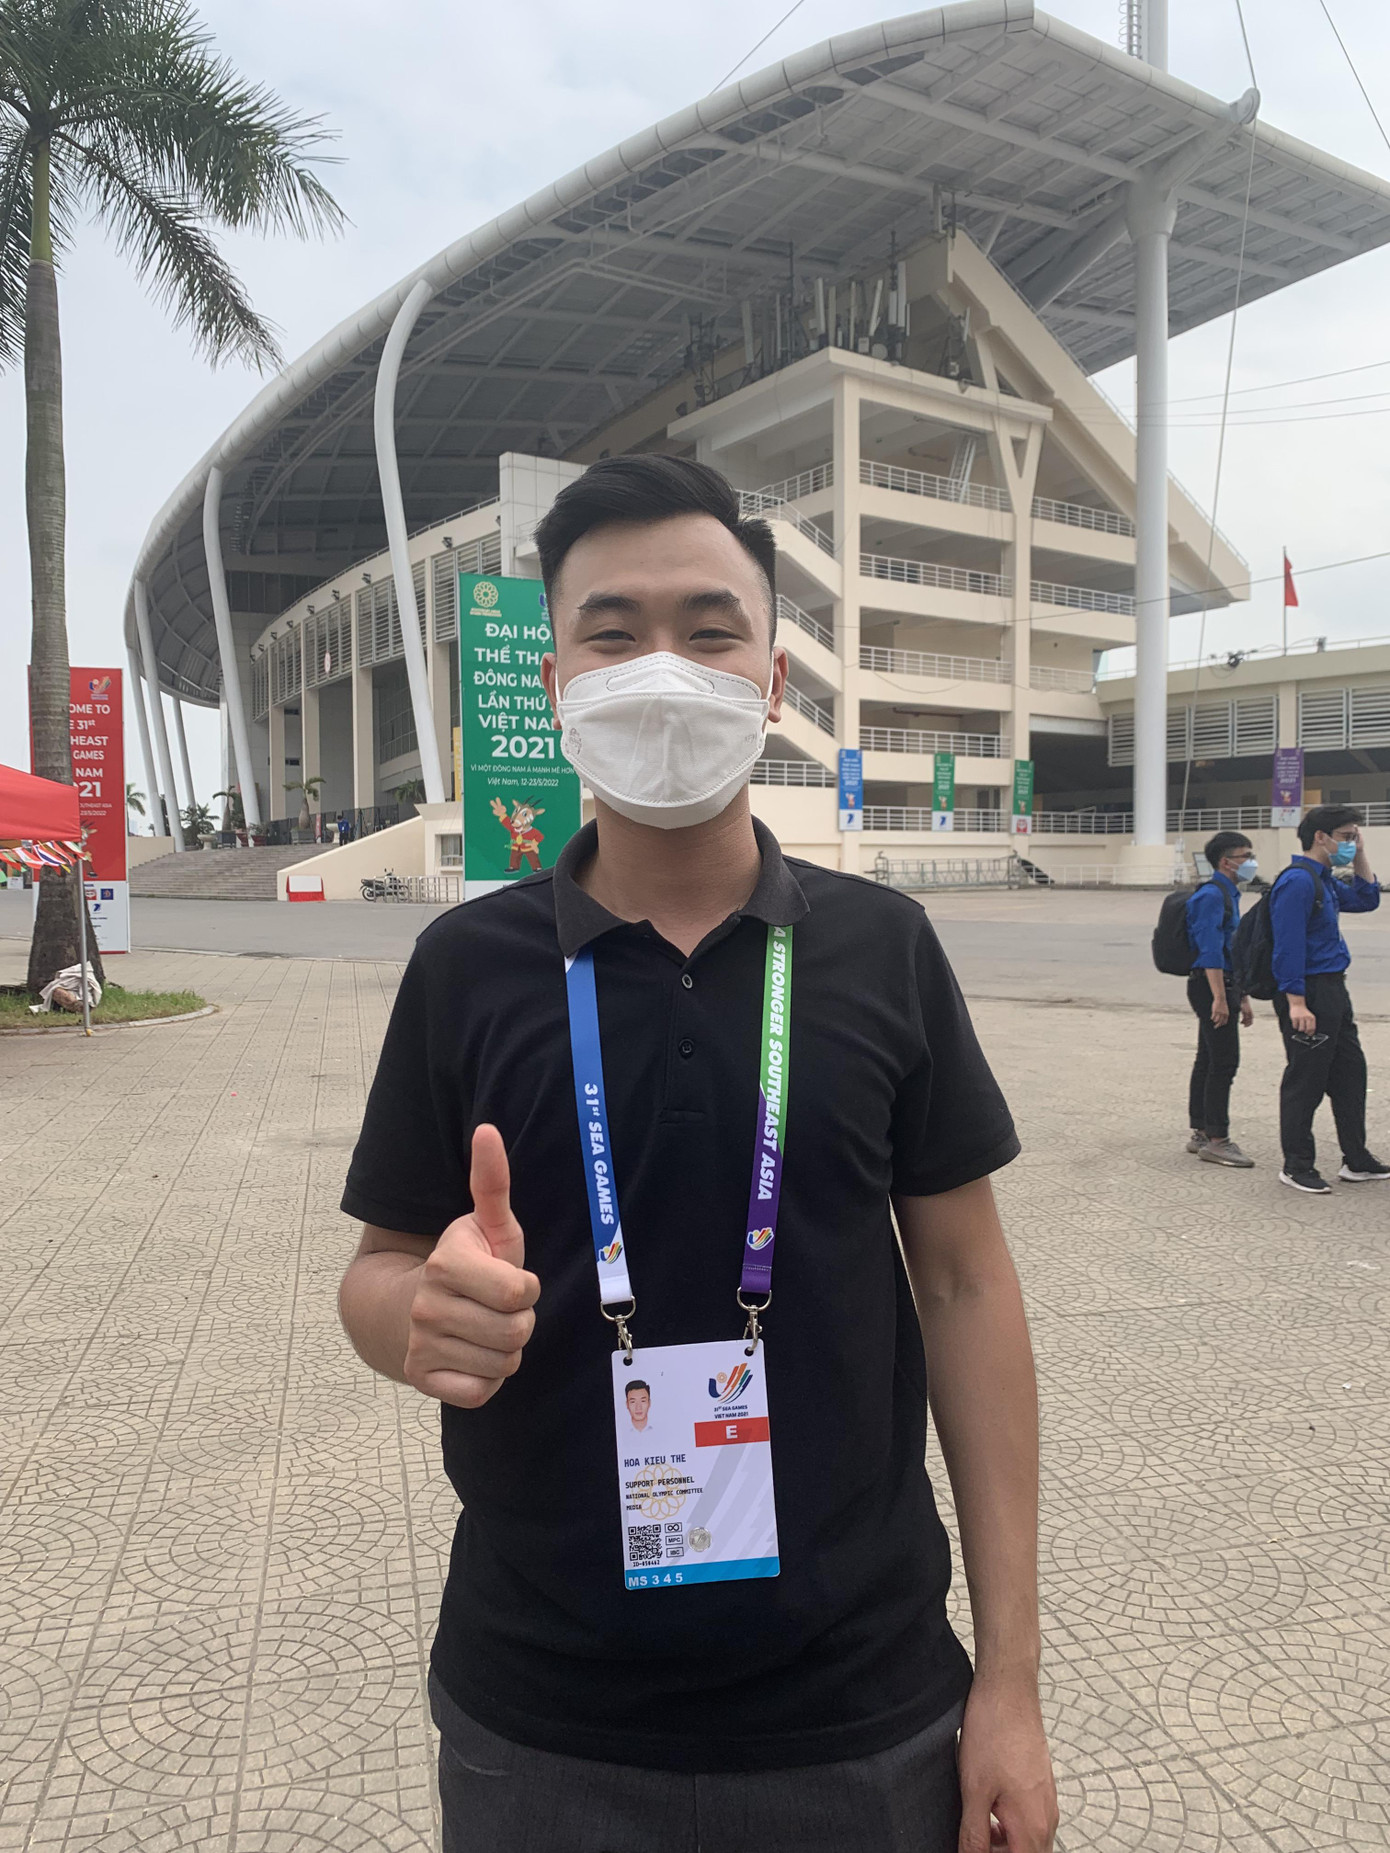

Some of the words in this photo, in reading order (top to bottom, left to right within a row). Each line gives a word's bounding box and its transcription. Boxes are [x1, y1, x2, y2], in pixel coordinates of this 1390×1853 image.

[485, 622, 517, 642] ĐẠI
[524, 624, 553, 644] HỘ
[474, 644, 511, 664] THỂ
[515, 651, 542, 665] TH
[473, 668, 517, 687] ĐÔNG
[522, 674, 544, 688] NA
[95, 704, 110, 714] TO
[478, 690, 509, 709] LẦN
[514, 693, 547, 711] THỨ
[77, 719, 95, 730] 31st
[478, 712, 519, 732] VIỆT
[73, 750, 104, 760] GAMES
[491, 735, 555, 759] 2021
[75, 768, 103, 777] NAM
[488, 777, 500, 786] Việt
[502, 778, 519, 786] Nam,
[521, 778, 559, 787] 12-23/5/2022
[73, 781, 101, 797] 21
[769, 941, 786, 1037] STRONGER
[584, 1083, 601, 1117] 31st
[763, 1038, 783, 1152] SOUTHEAST
[588, 1121, 605, 1156] SEA
[757, 1152, 776, 1200] ASIA
[594, 1159, 615, 1225] GAMES
[726, 1424, 738, 1439] E
[624, 1458, 640, 1467] HOA
[644, 1456, 666, 1466] KIEU
[671, 1453, 686, 1463] THE
[625, 1479, 654, 1489] SUPPORT
[657, 1476, 695, 1486] PERSONNEL
[628, 1576, 648, 1587] MS
[652, 1575, 660, 1585] 3
[663, 1574, 671, 1583] 4
[675, 1573, 683, 1582] 5
